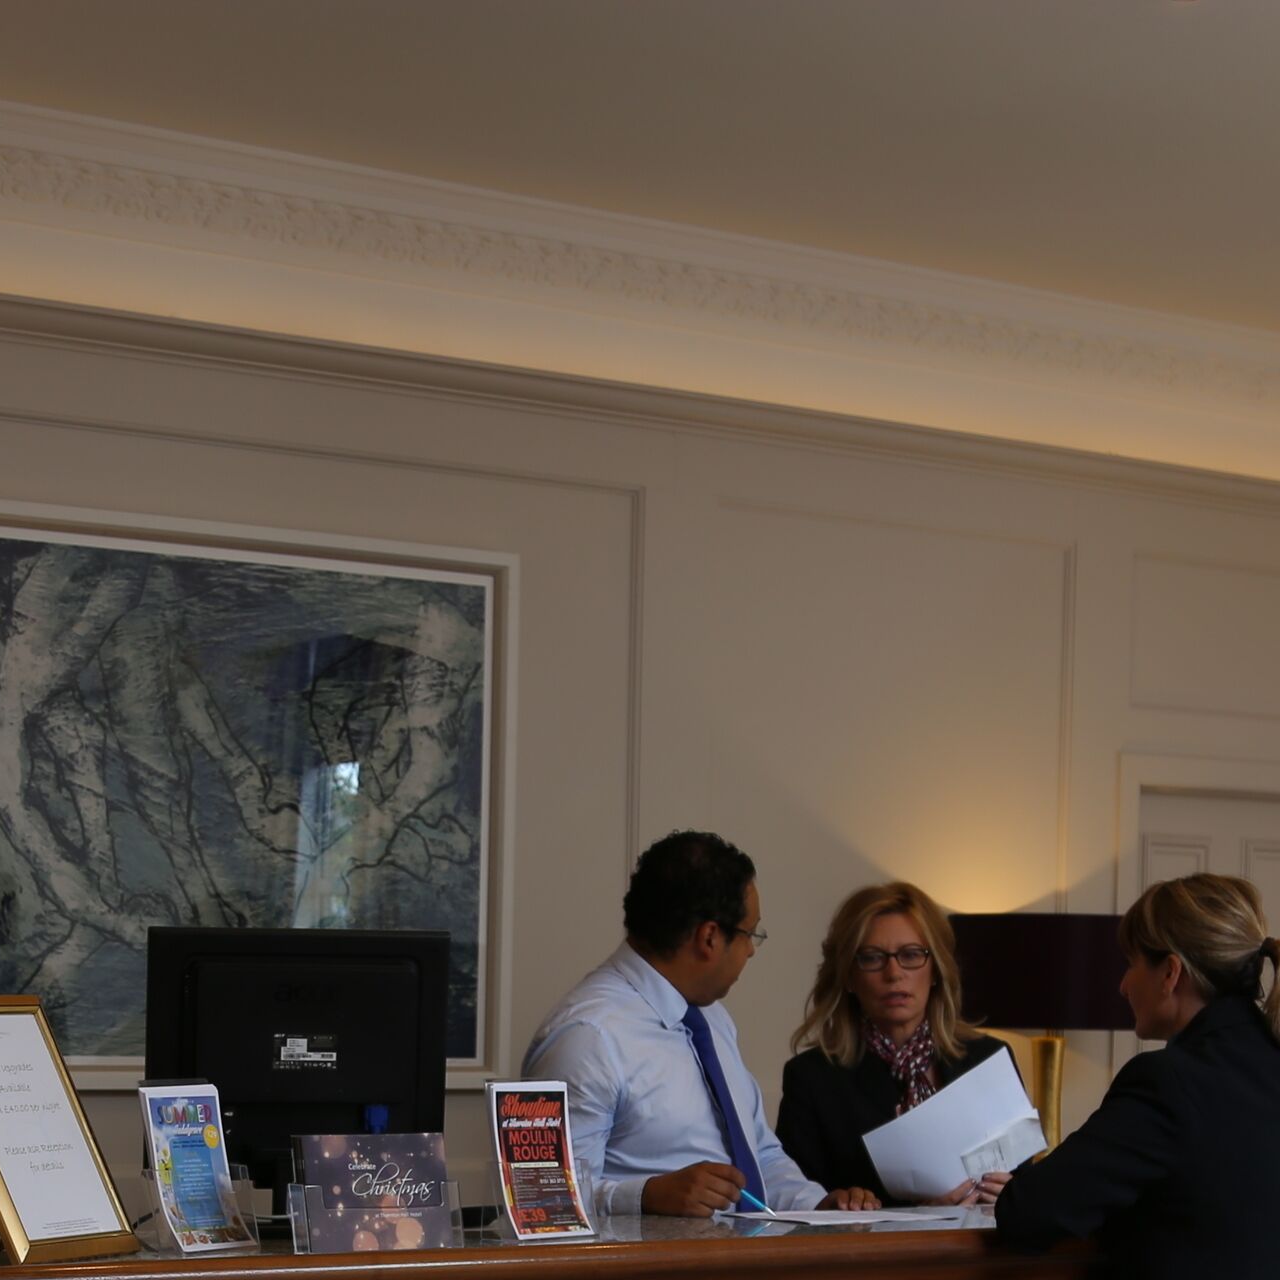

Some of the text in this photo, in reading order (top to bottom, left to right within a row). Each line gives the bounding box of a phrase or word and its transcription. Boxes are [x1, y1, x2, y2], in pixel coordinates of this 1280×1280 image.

[501, 1094, 561, 1118] Showtime
[157, 1104, 212, 1124] SUMMER
[509, 1130, 557, 1145] MOULIN
[512, 1145, 556, 1160] ROUGE
[348, 1162, 377, 1171] Celebrate
[352, 1162, 436, 1207] Christmas
[519, 1207, 547, 1222] £39
